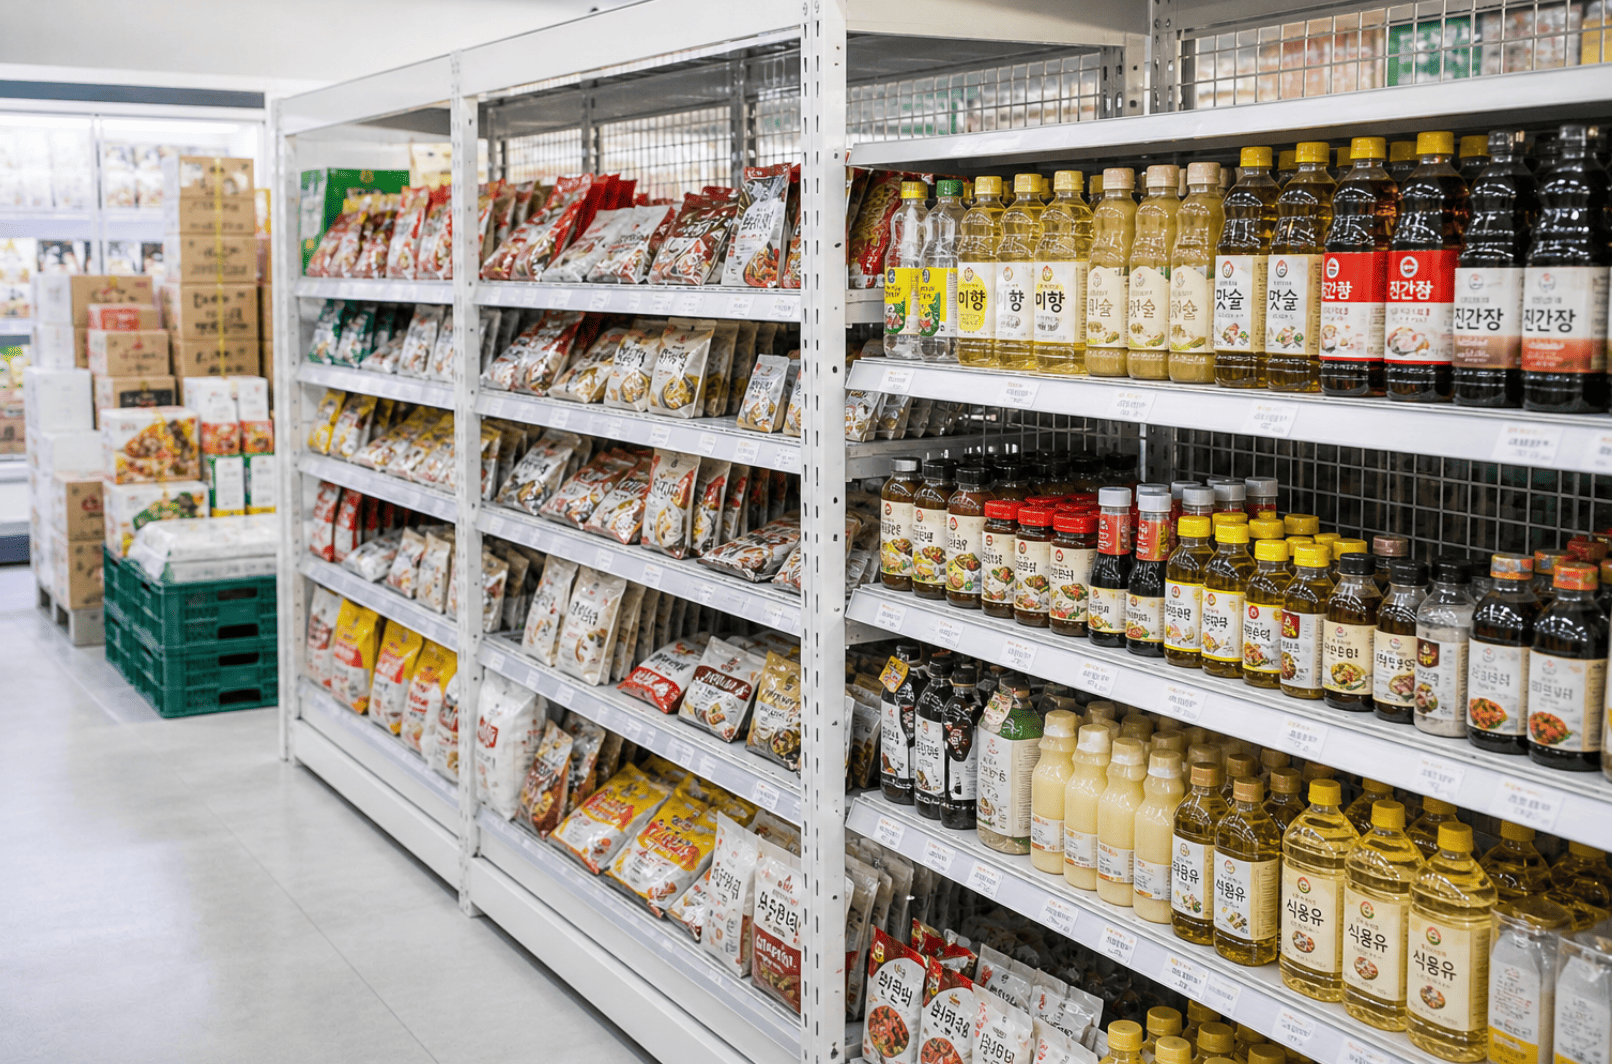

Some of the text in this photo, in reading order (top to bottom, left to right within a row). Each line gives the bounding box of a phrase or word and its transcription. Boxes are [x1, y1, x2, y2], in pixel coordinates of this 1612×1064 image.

[958, 289, 986, 311] 미향
[1035, 290, 1065, 313] 미향
[1455, 308, 1504, 331] 진간장
[1524, 308, 1576, 333] 진간장
[1287, 899, 1324, 926] 식용유
[1348, 923, 1388, 953] 식용유
[1413, 950, 1457, 981] 식용유
